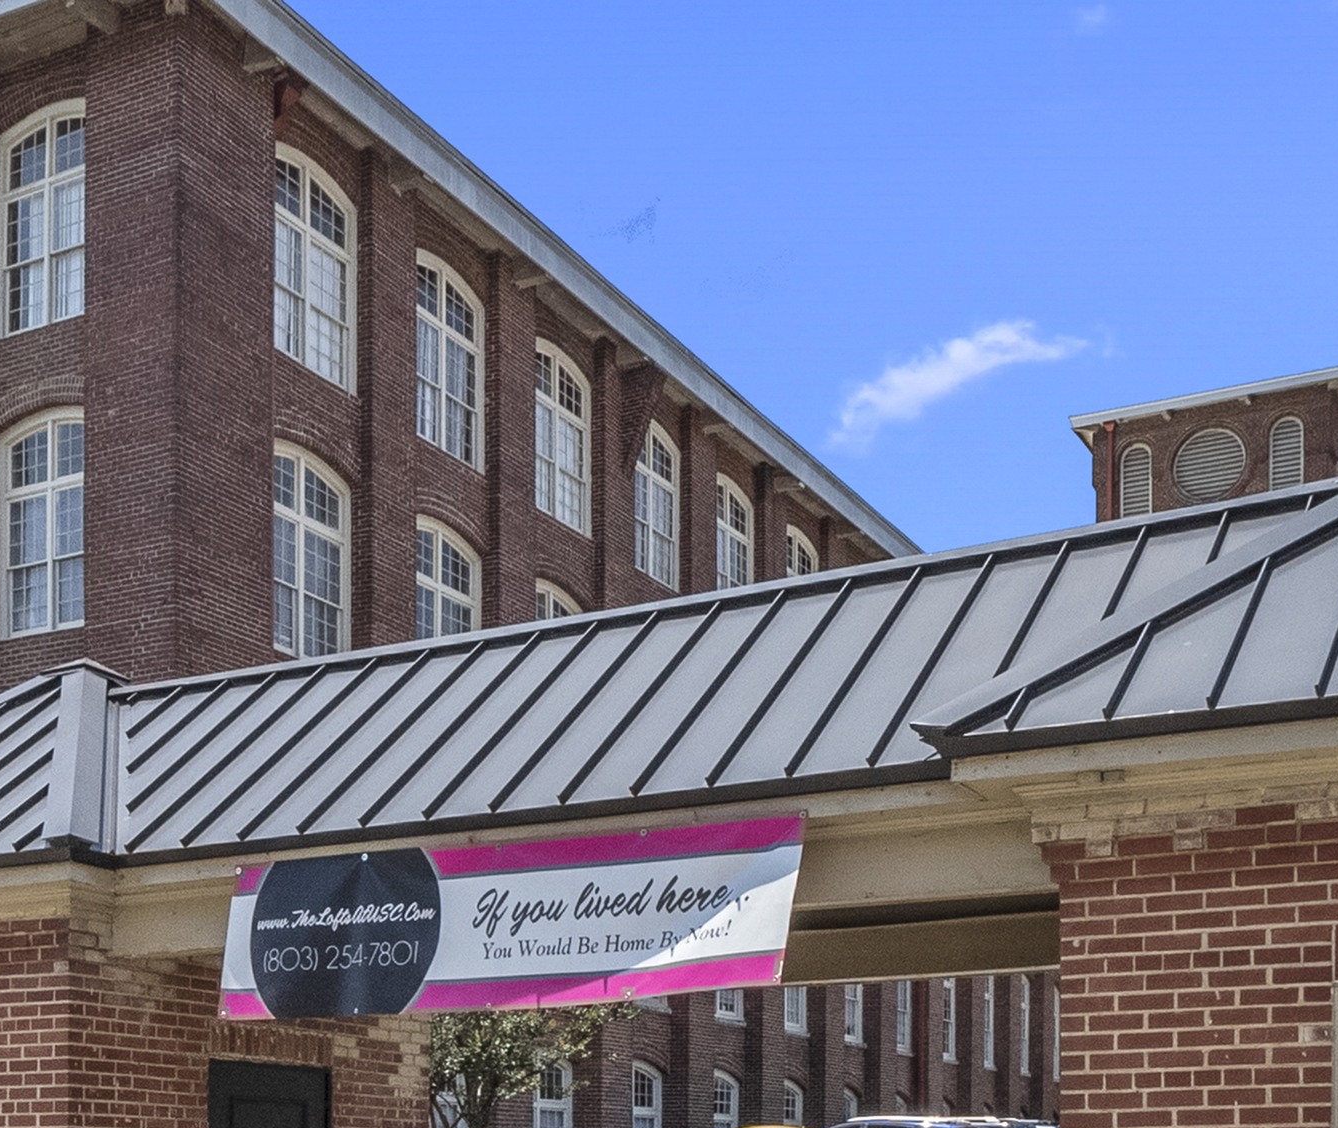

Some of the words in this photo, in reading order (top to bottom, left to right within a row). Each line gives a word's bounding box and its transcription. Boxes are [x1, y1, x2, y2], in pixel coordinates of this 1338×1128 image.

[472, 888, 510, 938] If
[510, 898, 569, 937] you
[573, 877, 654, 920] lived
[263, 945, 319, 973] (803)
[324, 940, 419, 970] 254-7801
[482, 942, 512, 960] You
[517, 936, 573, 957] Would
[576, 936, 599, 955] Be
[604, 934, 655, 954] Home
[659, 930, 683, 952] By
[685, 919, 732, 944] Now!
